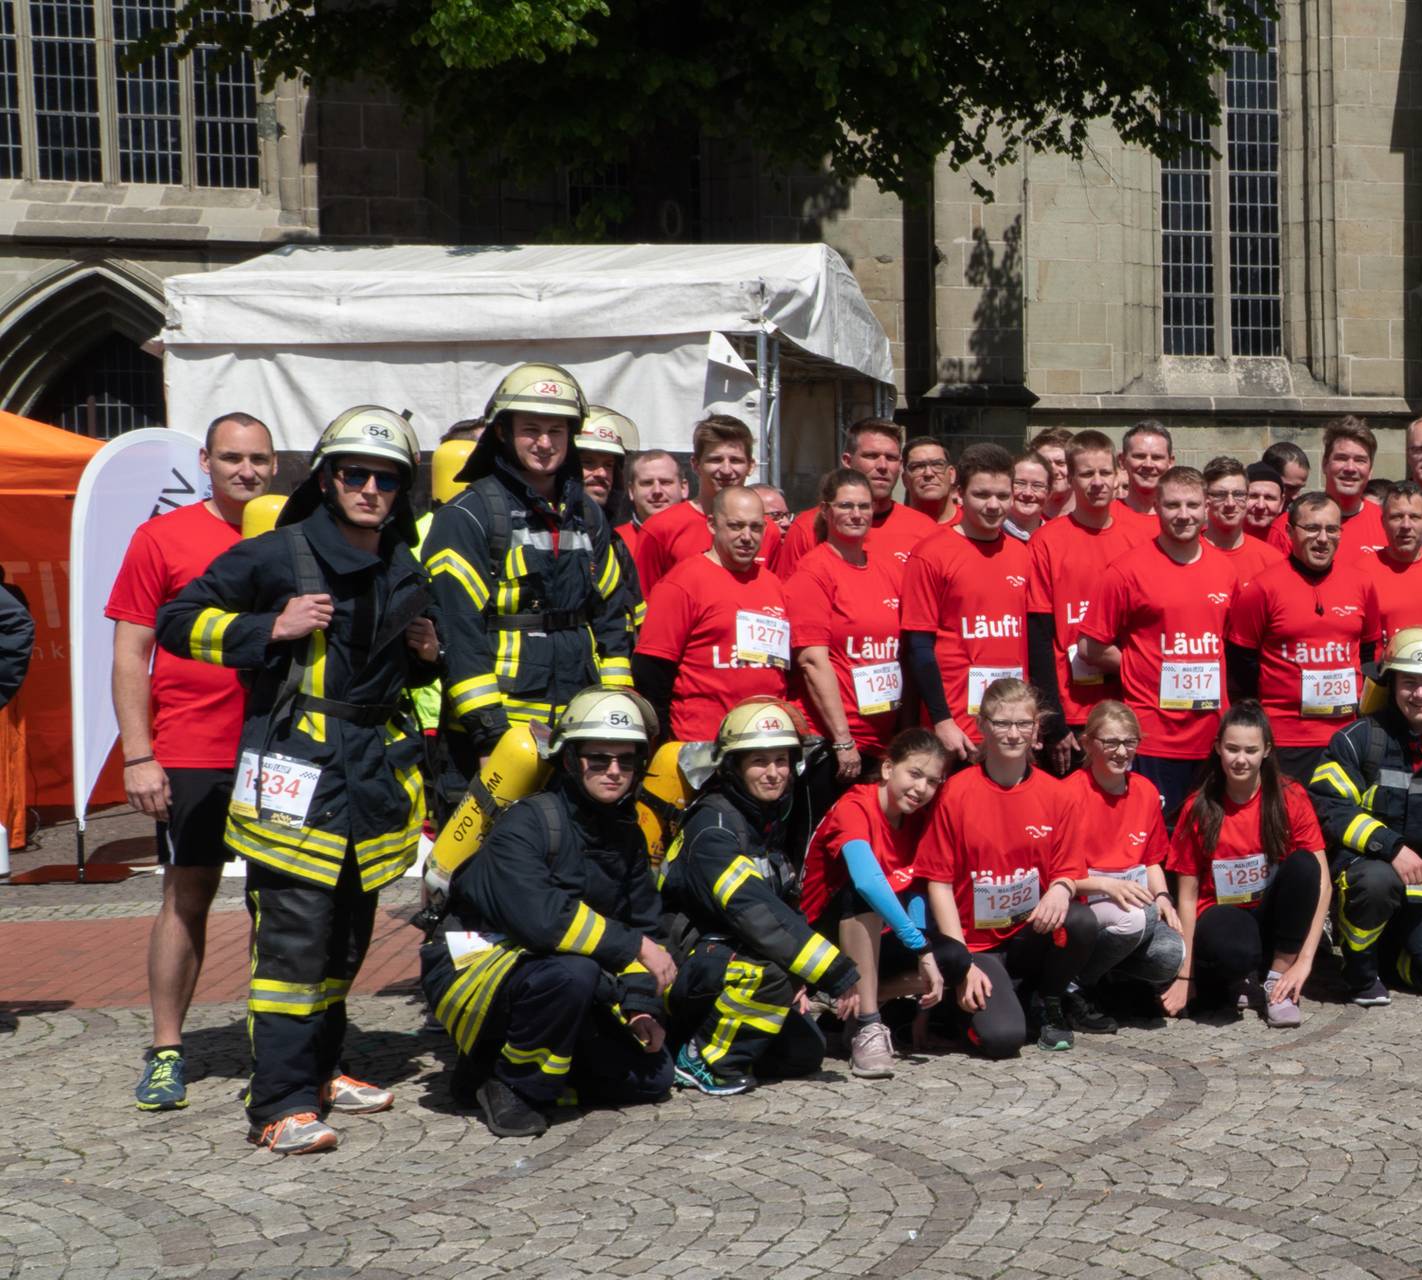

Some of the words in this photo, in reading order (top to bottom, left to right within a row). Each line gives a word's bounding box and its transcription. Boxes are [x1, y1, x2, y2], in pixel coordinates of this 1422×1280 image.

[541, 383, 557, 394] 24
[368, 426, 389, 439] 54
[598, 428, 614, 439] 54
[748, 624, 784, 645] 1277
[866, 673, 899, 693] 1248
[1172, 673, 1213, 690] 1317
[1313, 679, 1351, 697] 1239
[610, 713, 630, 726] 54
[244, 768, 302, 799] 1234
[1225, 863, 1271, 886] 1258
[987, 886, 1033, 910] 1252
